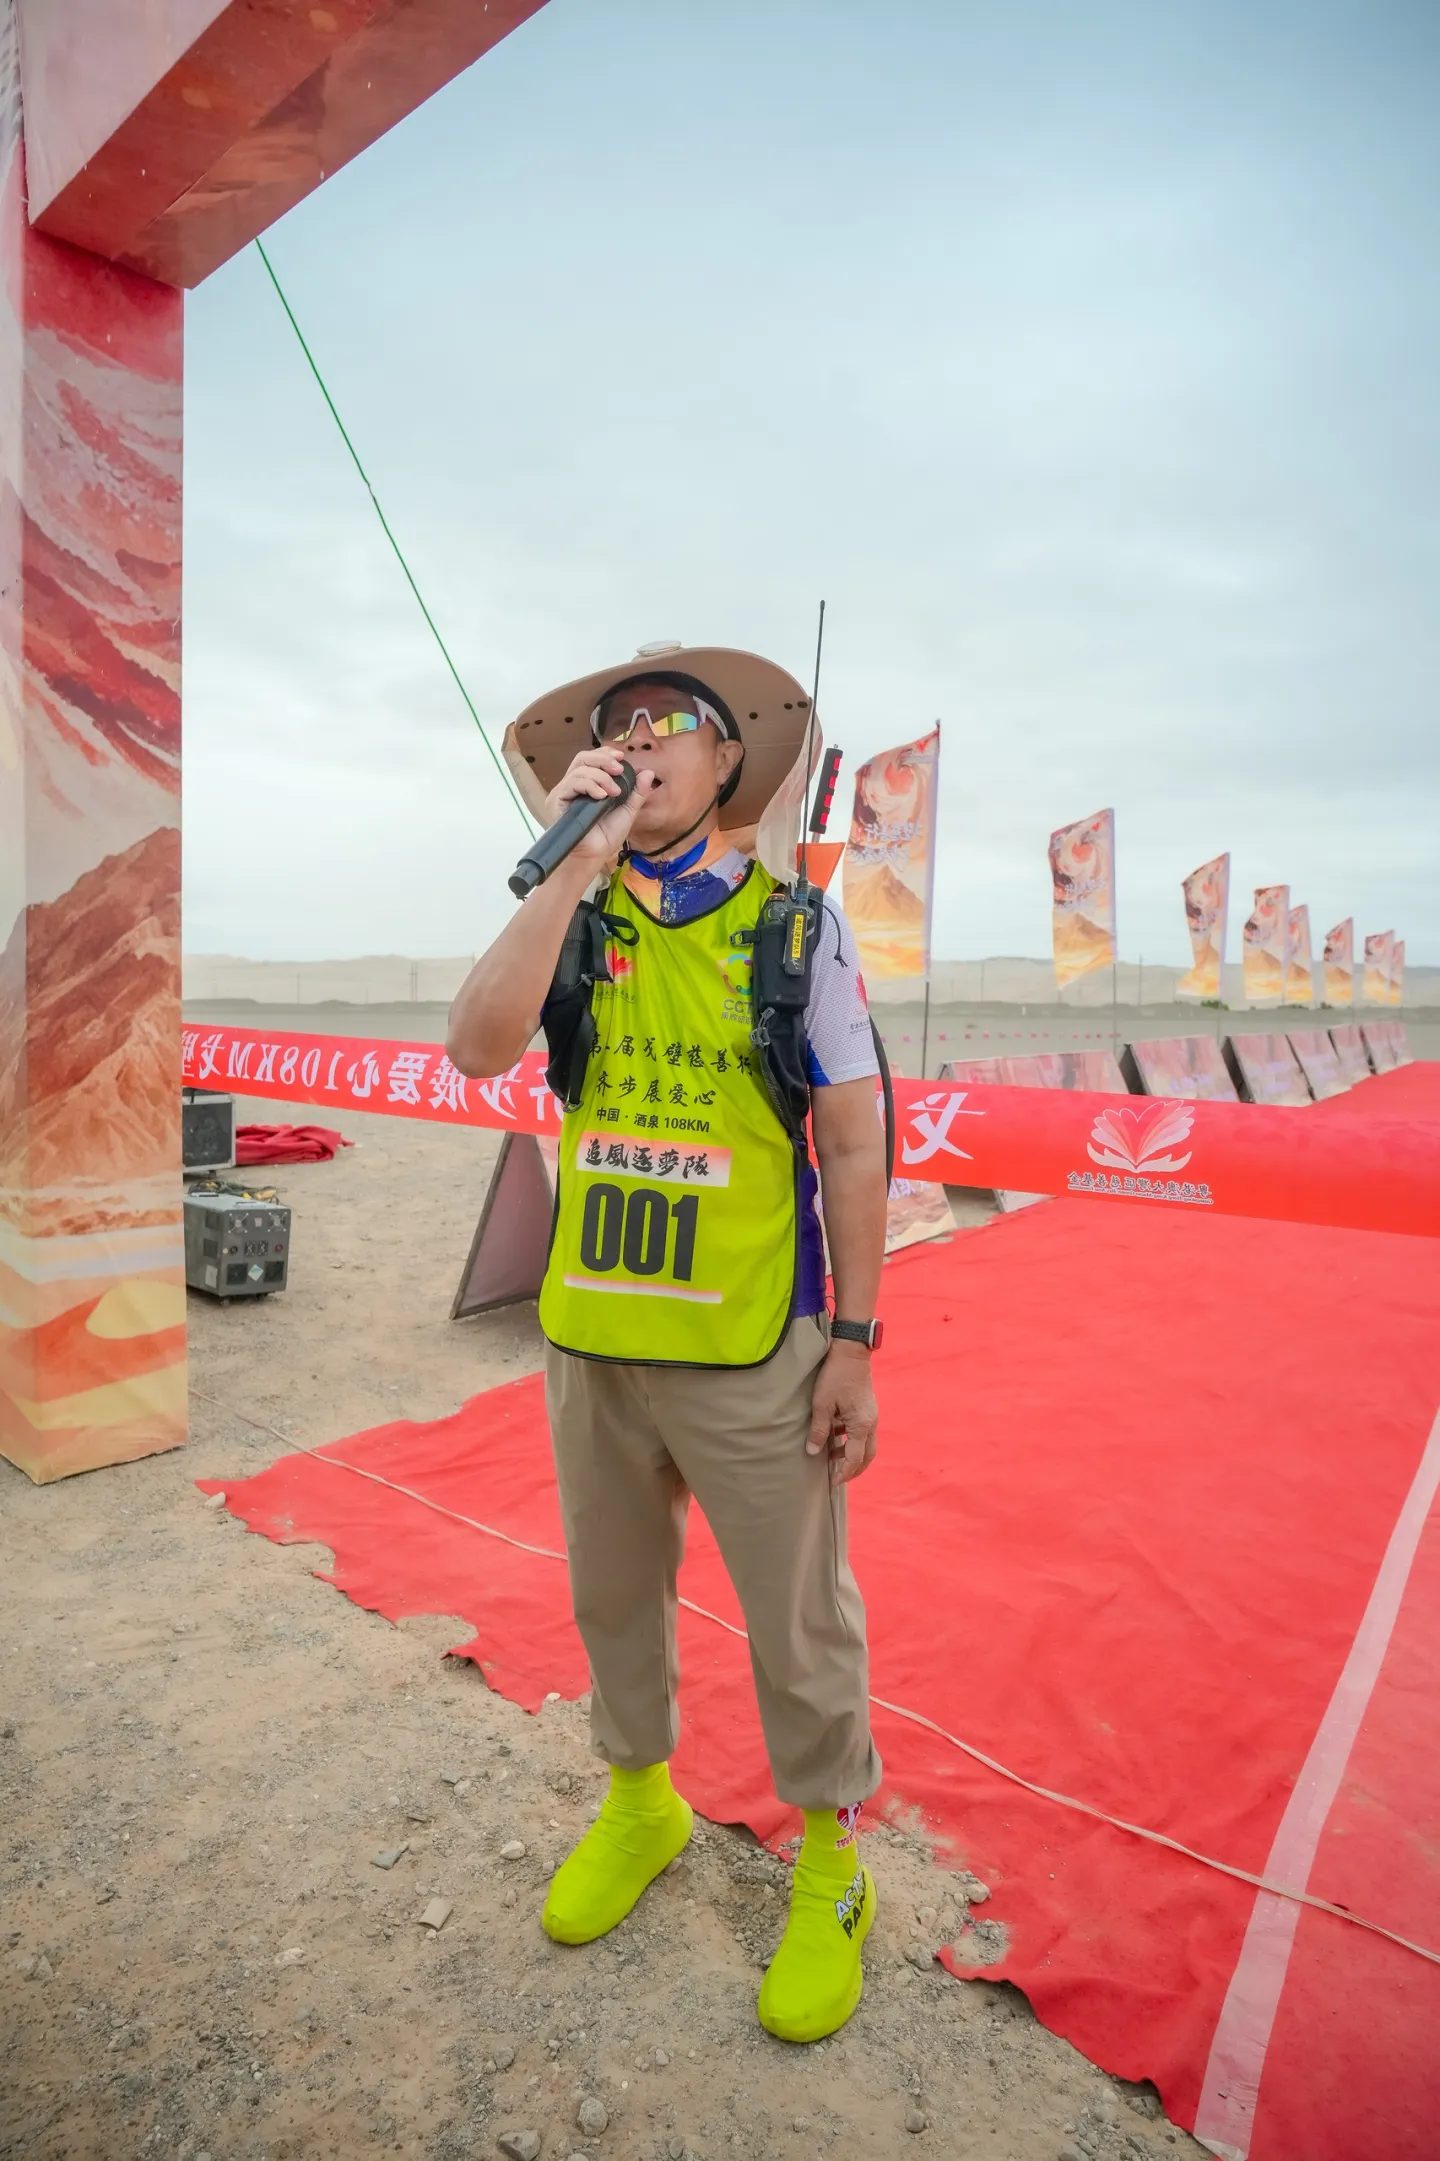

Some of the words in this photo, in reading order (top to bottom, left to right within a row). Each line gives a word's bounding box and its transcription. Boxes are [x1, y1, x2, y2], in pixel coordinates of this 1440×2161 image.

[596, 1070, 717, 1107] 齐步展爱心
[664, 1116, 710, 1133] 108KM
[580, 1182, 700, 1282] 001
